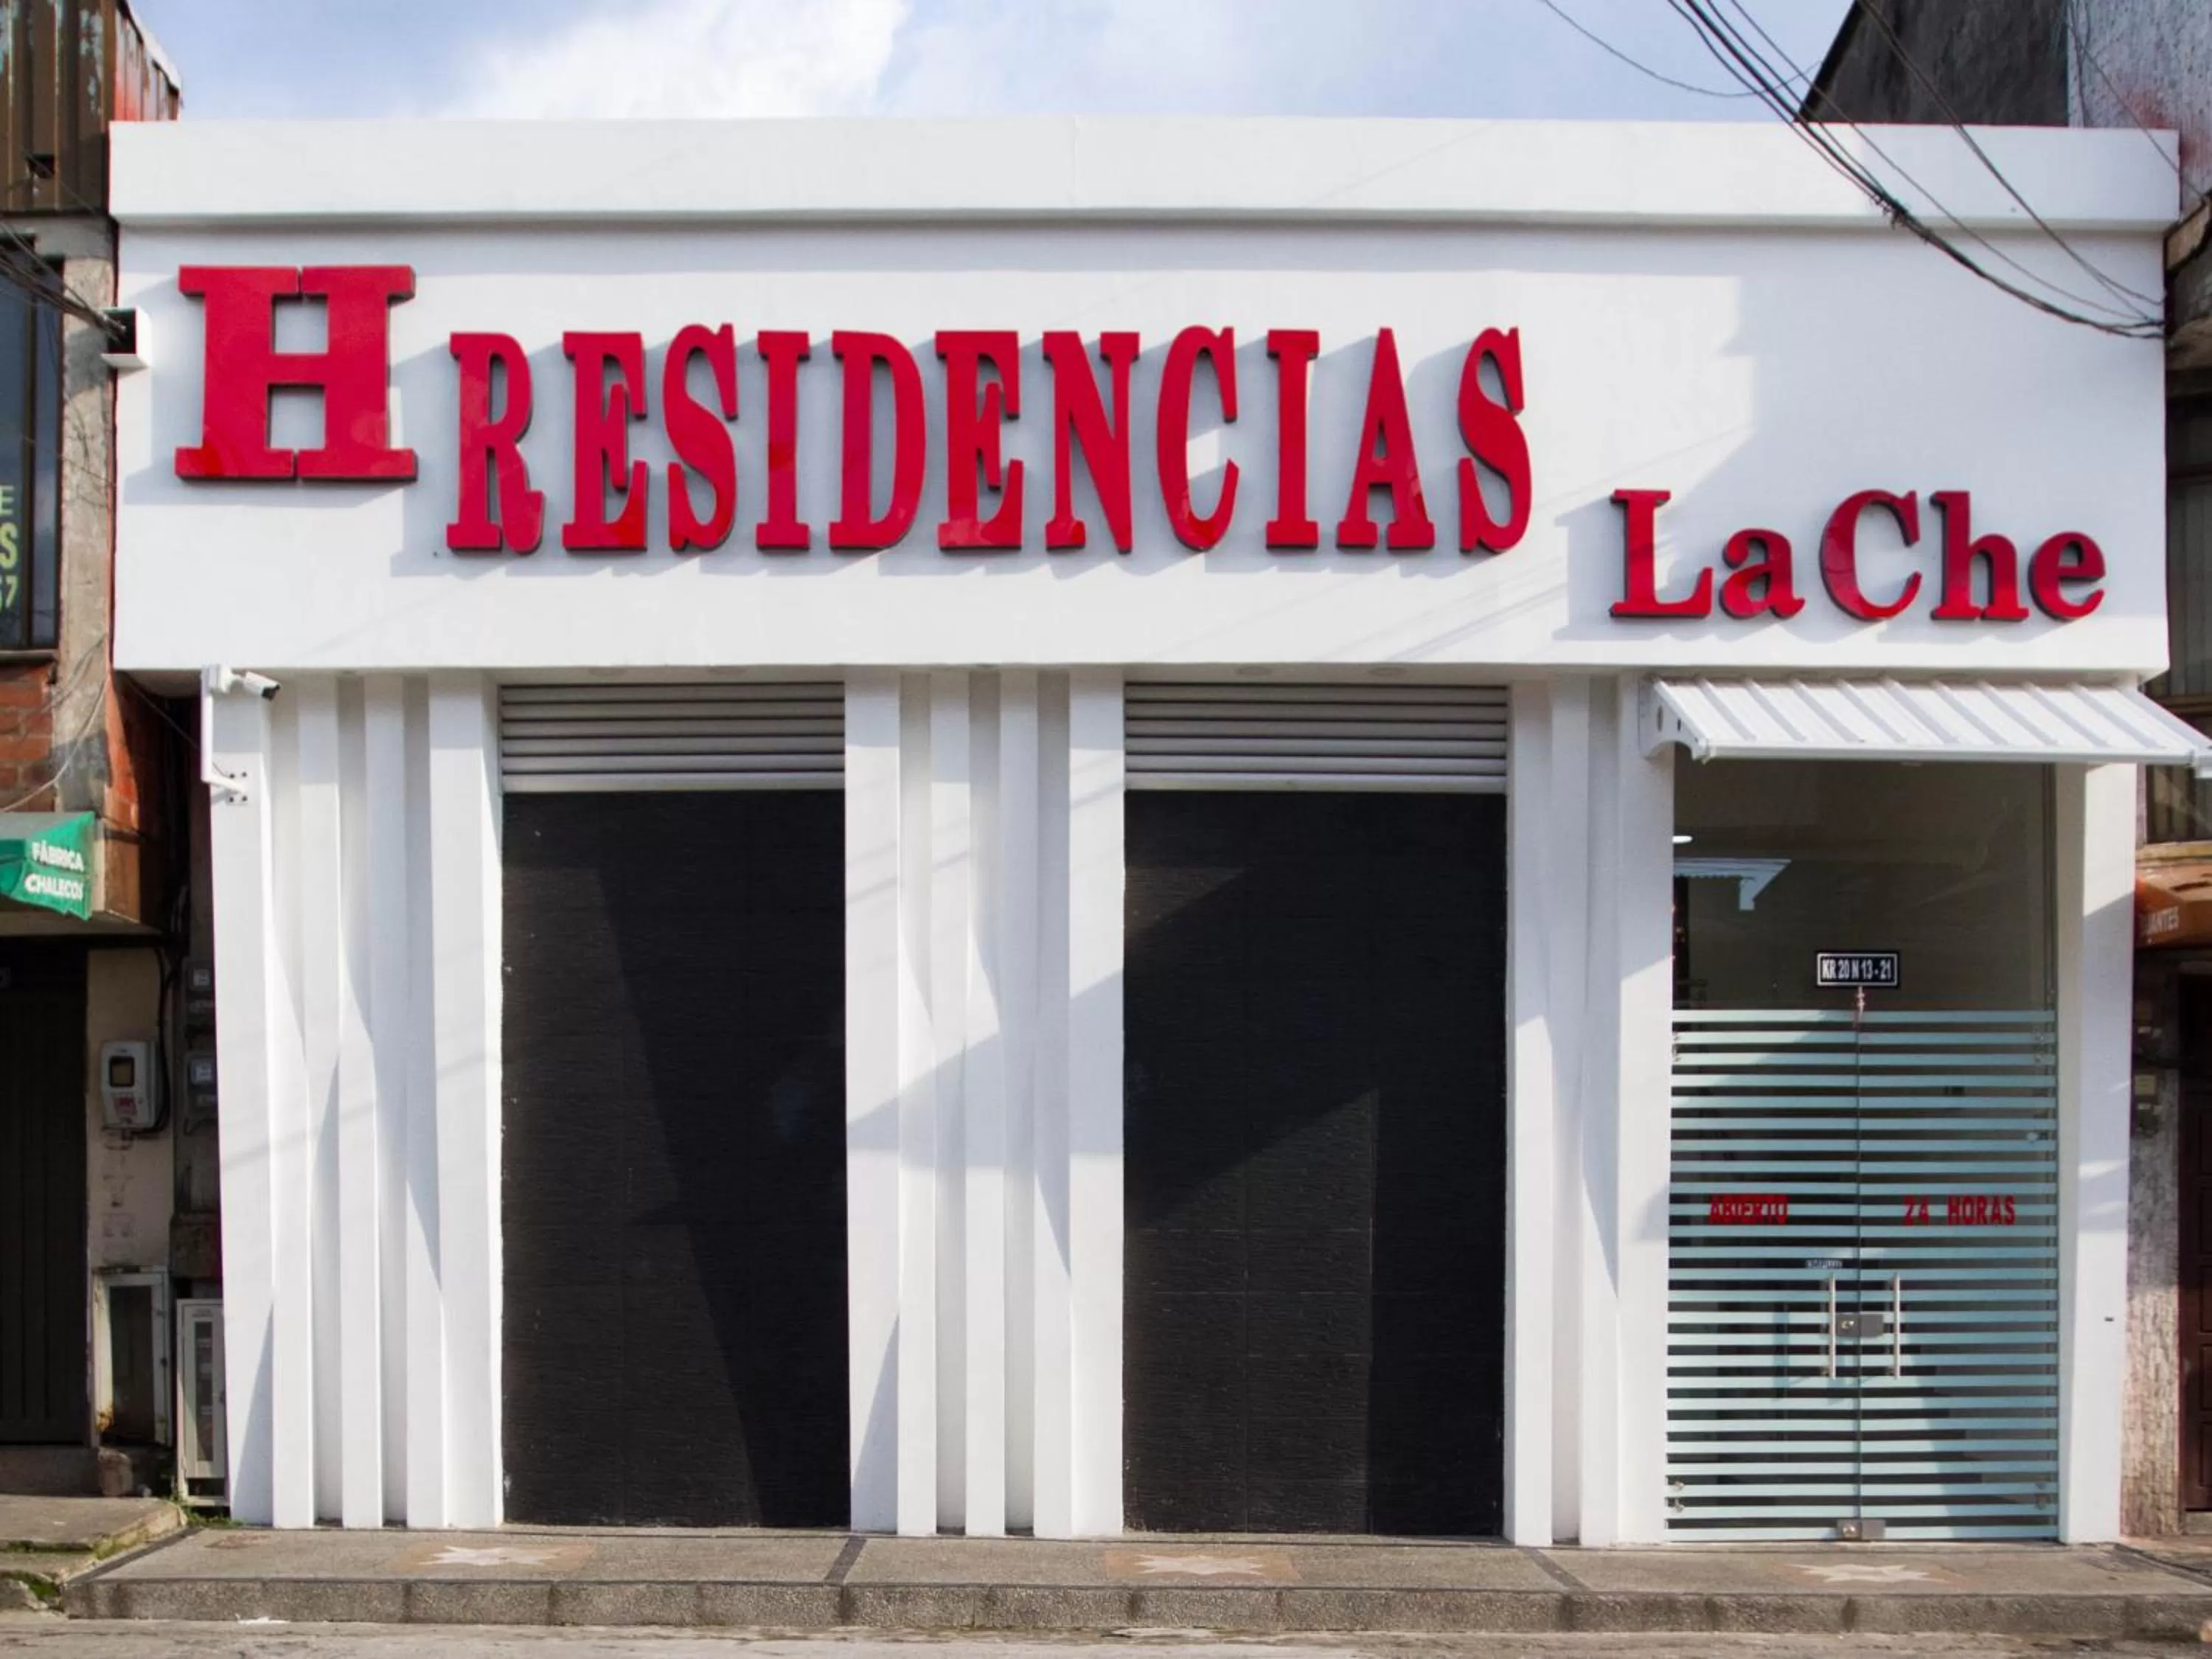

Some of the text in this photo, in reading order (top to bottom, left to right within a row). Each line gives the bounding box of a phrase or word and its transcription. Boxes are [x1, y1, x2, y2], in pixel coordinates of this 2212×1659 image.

[174, 264, 1534, 554] H RESIDENCIAS
[1822, 959, 1836, 979] KR
[1837, 959, 1850, 979] 20
[1708, 1193, 2016, 1226] ABIERTO 24 HORAS
